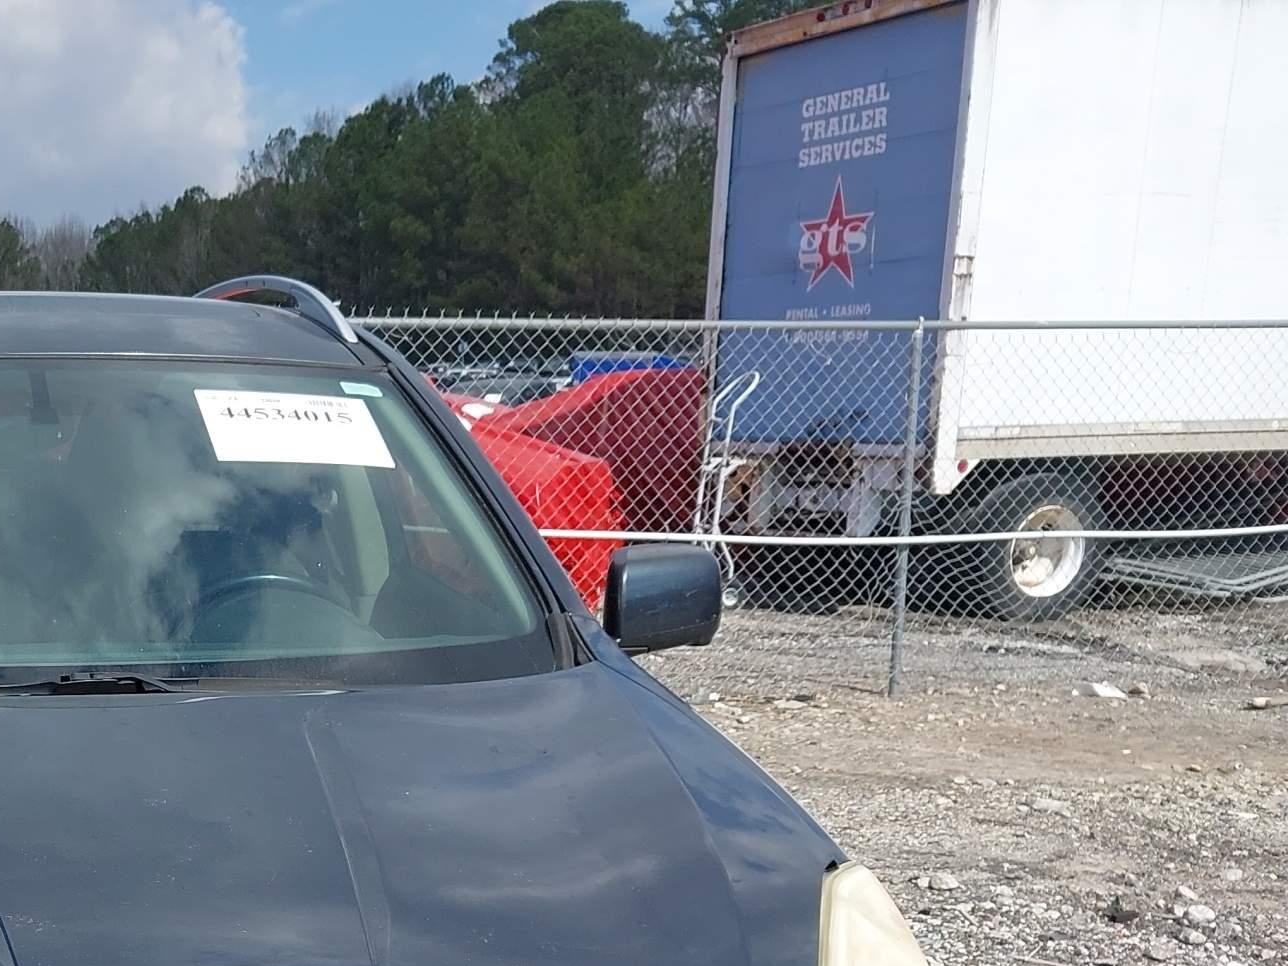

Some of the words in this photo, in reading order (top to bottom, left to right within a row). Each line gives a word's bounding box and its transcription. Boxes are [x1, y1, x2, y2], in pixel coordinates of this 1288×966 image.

[802, 81, 890, 118] GENERAL
[800, 107, 888, 143] TRAILER
[798, 133, 887, 169] SERVICES
[798, 217, 867, 273] gts
[785, 306, 818, 321] RENTAL
[830, 303, 872, 318] LEASING
[219, 406, 353, 424] 44534015
